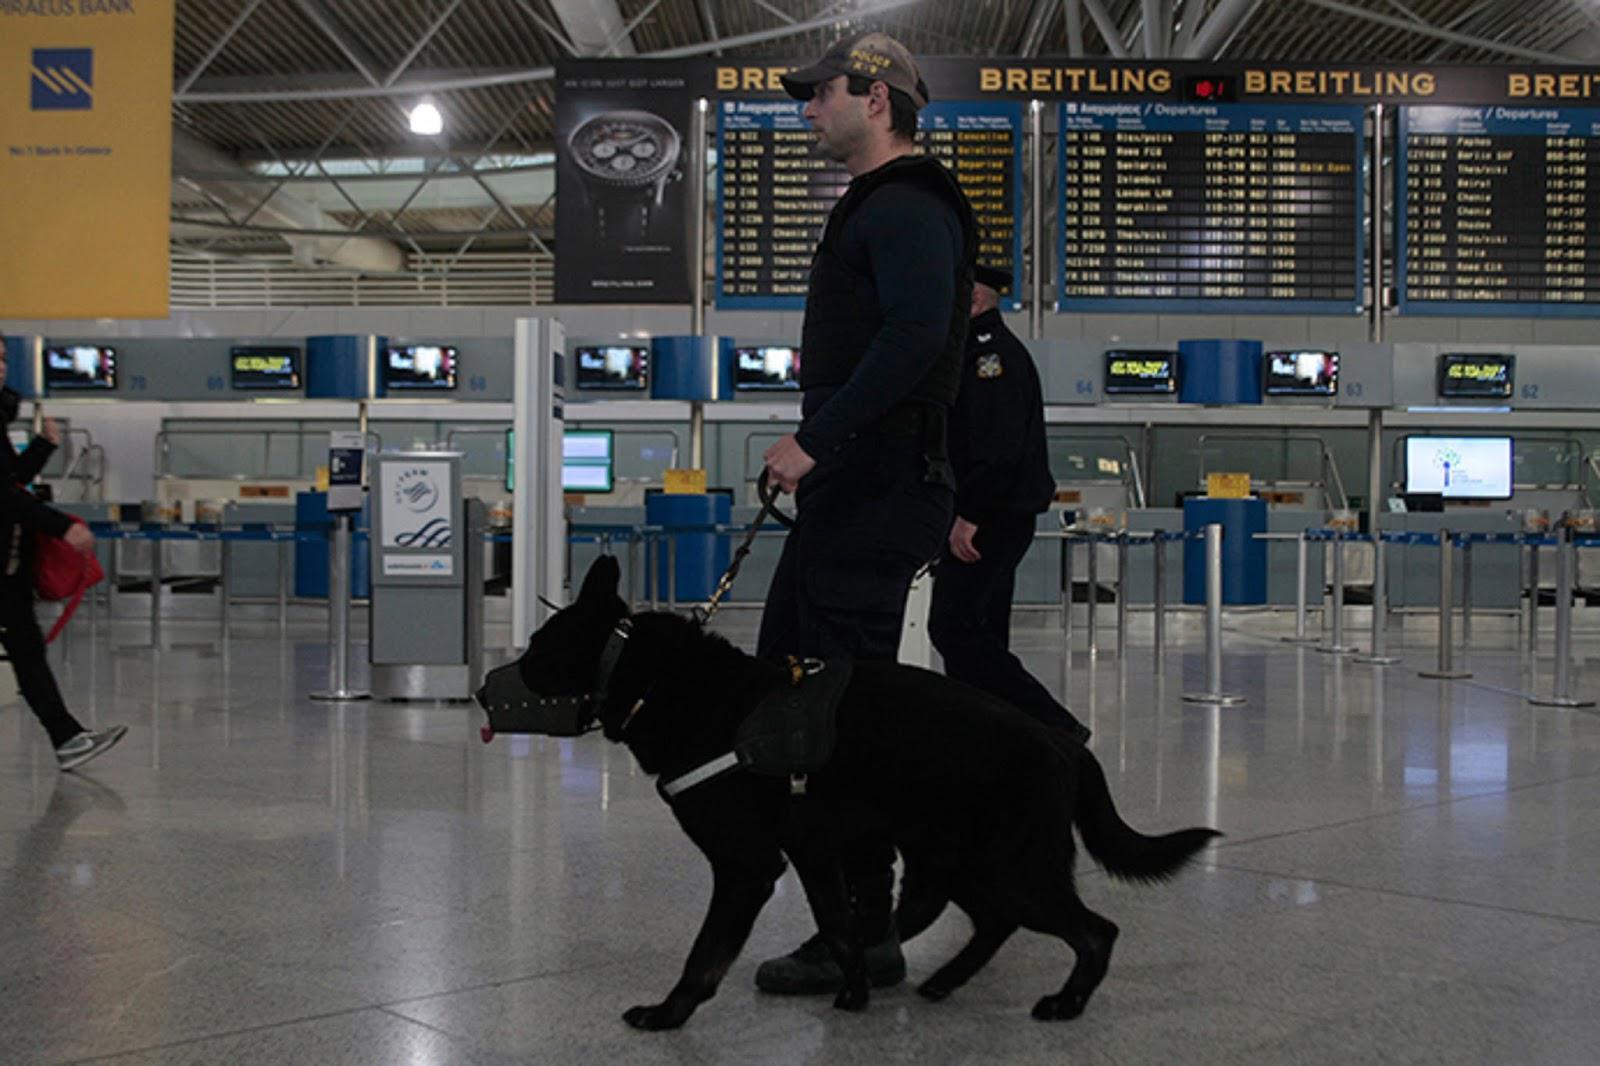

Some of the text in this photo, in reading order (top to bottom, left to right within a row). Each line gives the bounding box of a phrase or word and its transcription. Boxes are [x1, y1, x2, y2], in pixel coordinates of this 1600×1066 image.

[850, 49, 892, 69] POLICE
[852, 61, 879, 75] K-9
[717, 67, 799, 91] BRE
[980, 68, 1172, 93] BREITLING
[1244, 70, 1436, 96] BREITLING
[1155, 104, 1218, 117] Departures
[1496, 108, 1559, 121] Departures
[774, 145, 808, 155] Zurich
[1117, 146, 1139, 156] Rome
[958, 160, 1003, 170] Departed
[1117, 160, 1167, 170] Santorini
[1328, 162, 1351, 173] Open
[958, 174, 1003, 184] Departed
[774, 187, 808, 197] Rhodes
[1116, 188, 1151, 198] London
[1457, 192, 1491, 202] Chania
[1116, 202, 1168, 212] Heraklion
[1457, 205, 1491, 215] Chania
[1116, 216, 1134, 226] Kos
[774, 228, 808, 238] Chania
[773, 242, 808, 252] London
[1457, 247, 1486, 257] Sofia
[1457, 261, 1480, 271] Rome
[1115, 285, 1151, 295] London
[1521, 384, 1538, 400] 62
